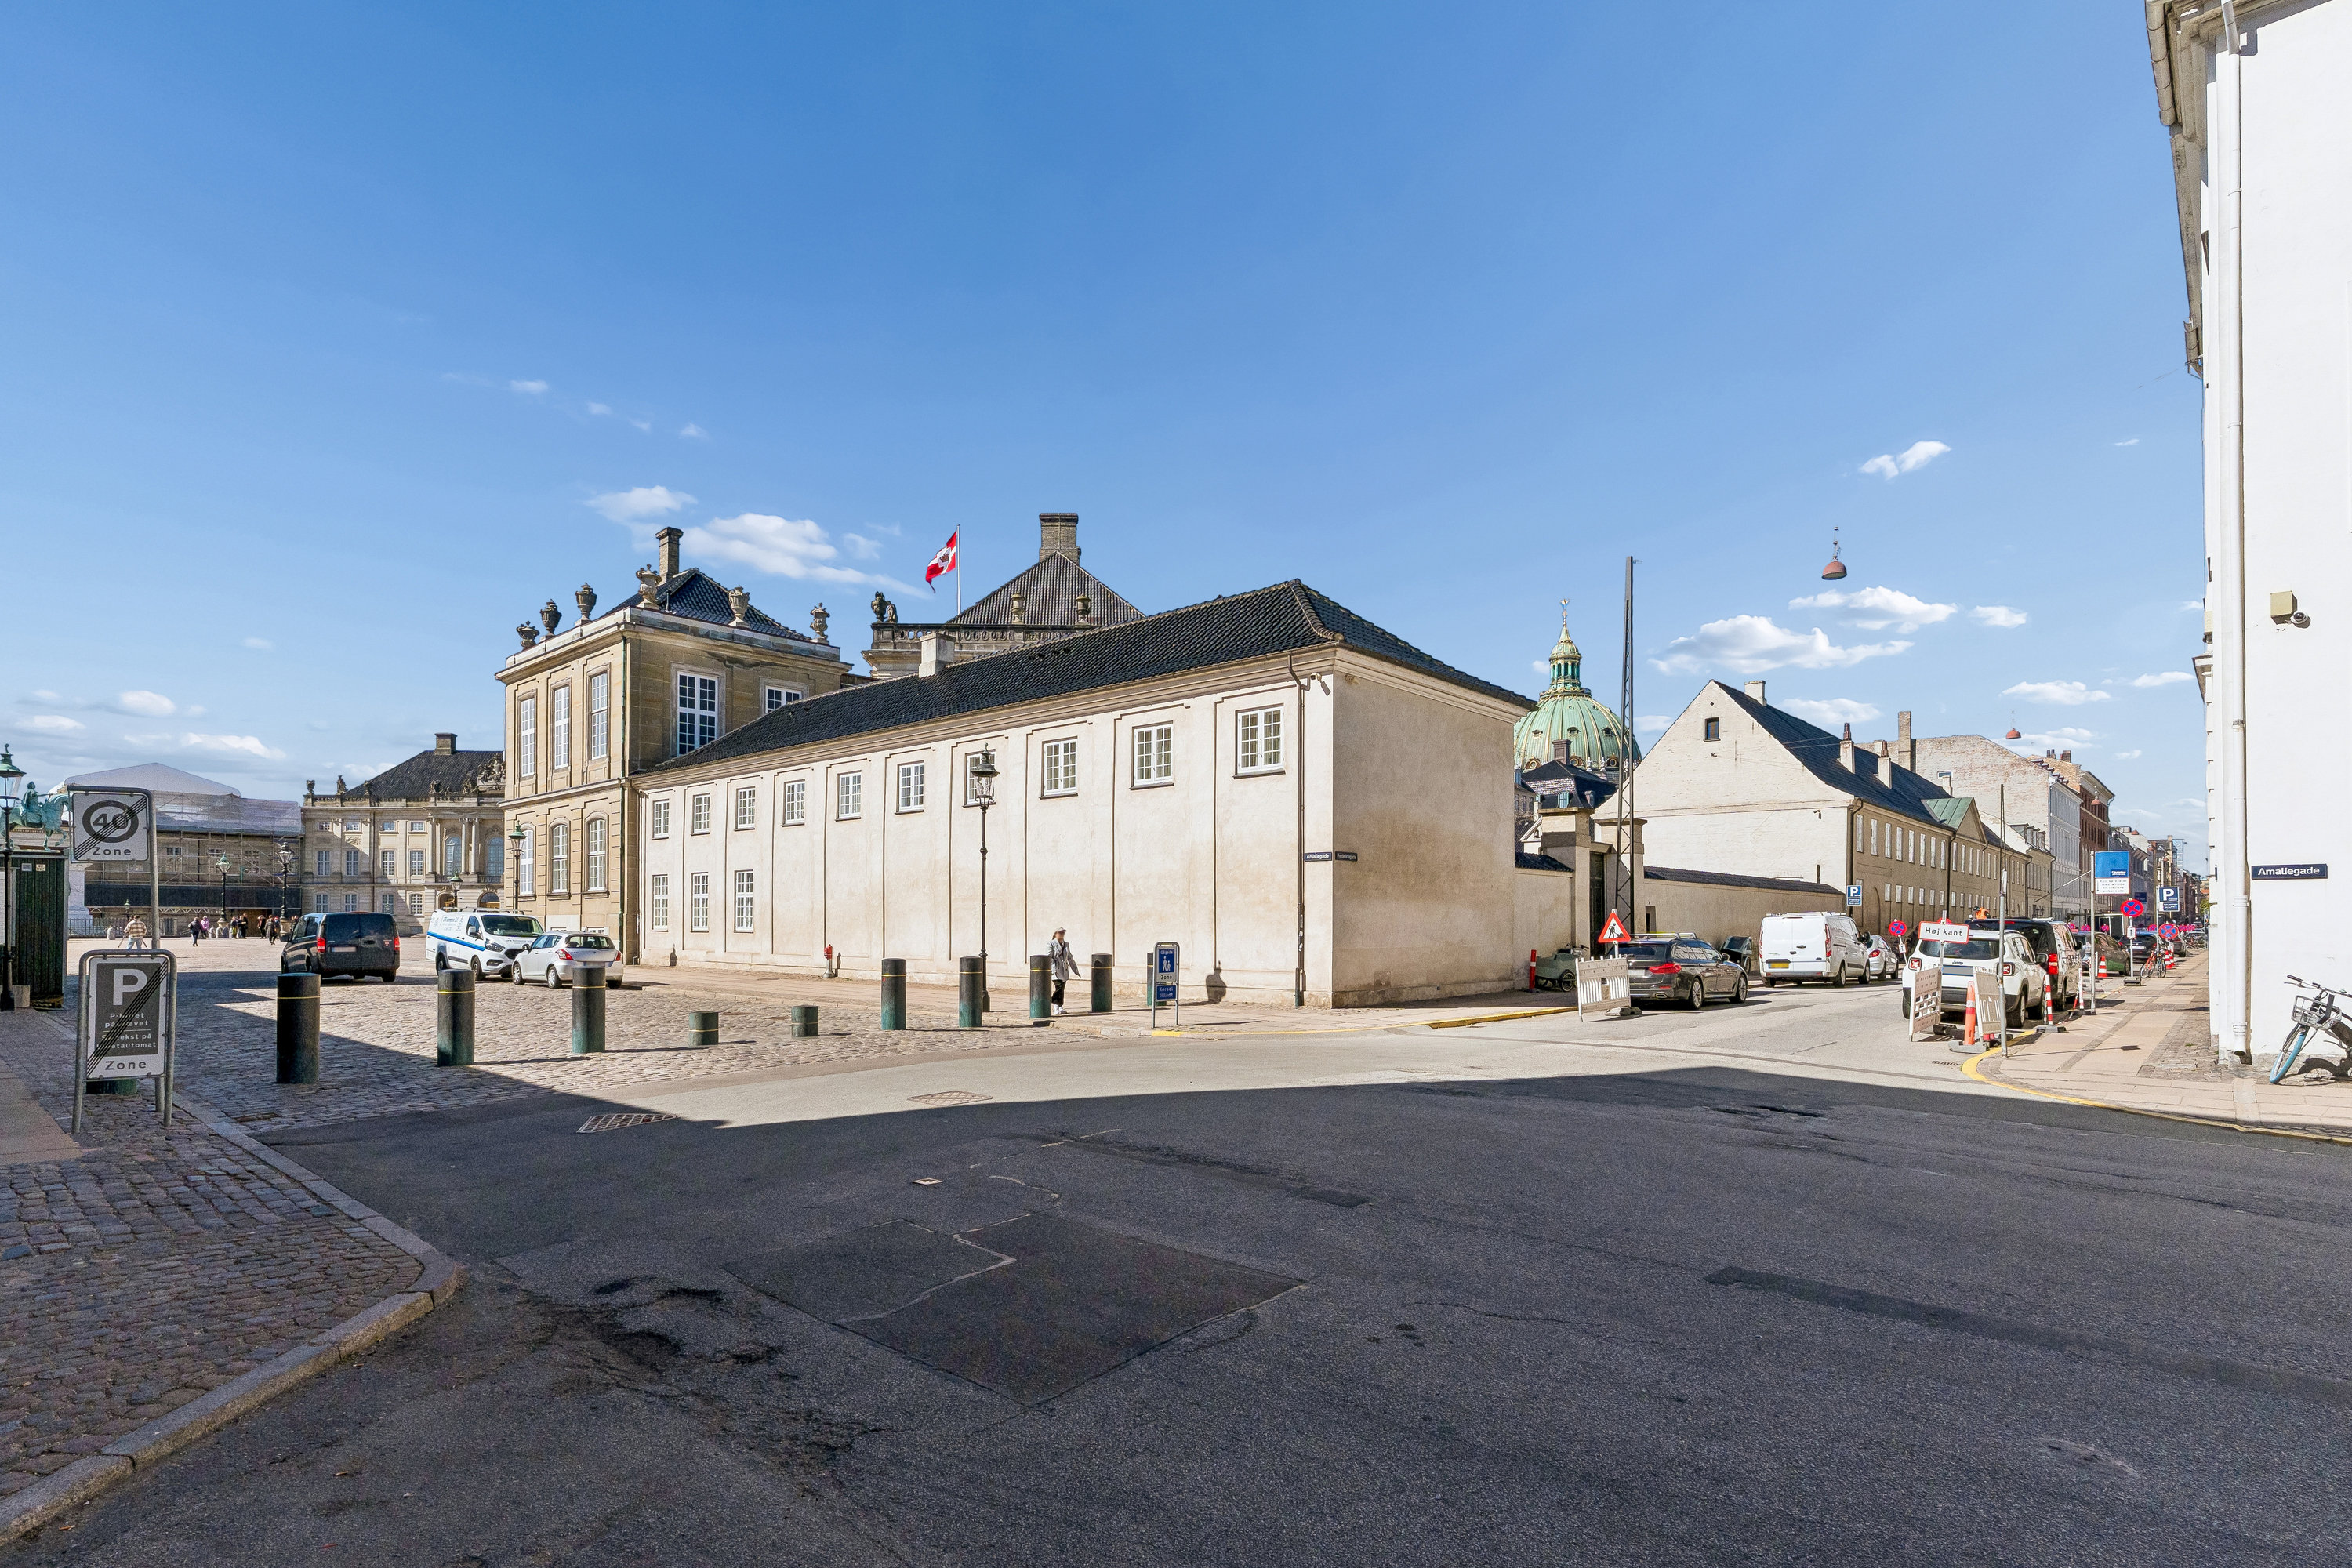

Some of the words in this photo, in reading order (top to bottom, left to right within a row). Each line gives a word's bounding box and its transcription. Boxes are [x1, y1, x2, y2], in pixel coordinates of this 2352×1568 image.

[93, 813, 129, 829] 40
[93, 847, 132, 855] Zone
[2258, 867, 2320, 877] Amaliegade
[1850, 887, 1859, 897] P
[2162, 888, 2175, 901] P
[1925, 927, 1940, 935] Høj
[1943, 928, 1963, 937] kant
[112, 968, 147, 1006] P
[104, 1061, 147, 1071] Zone
